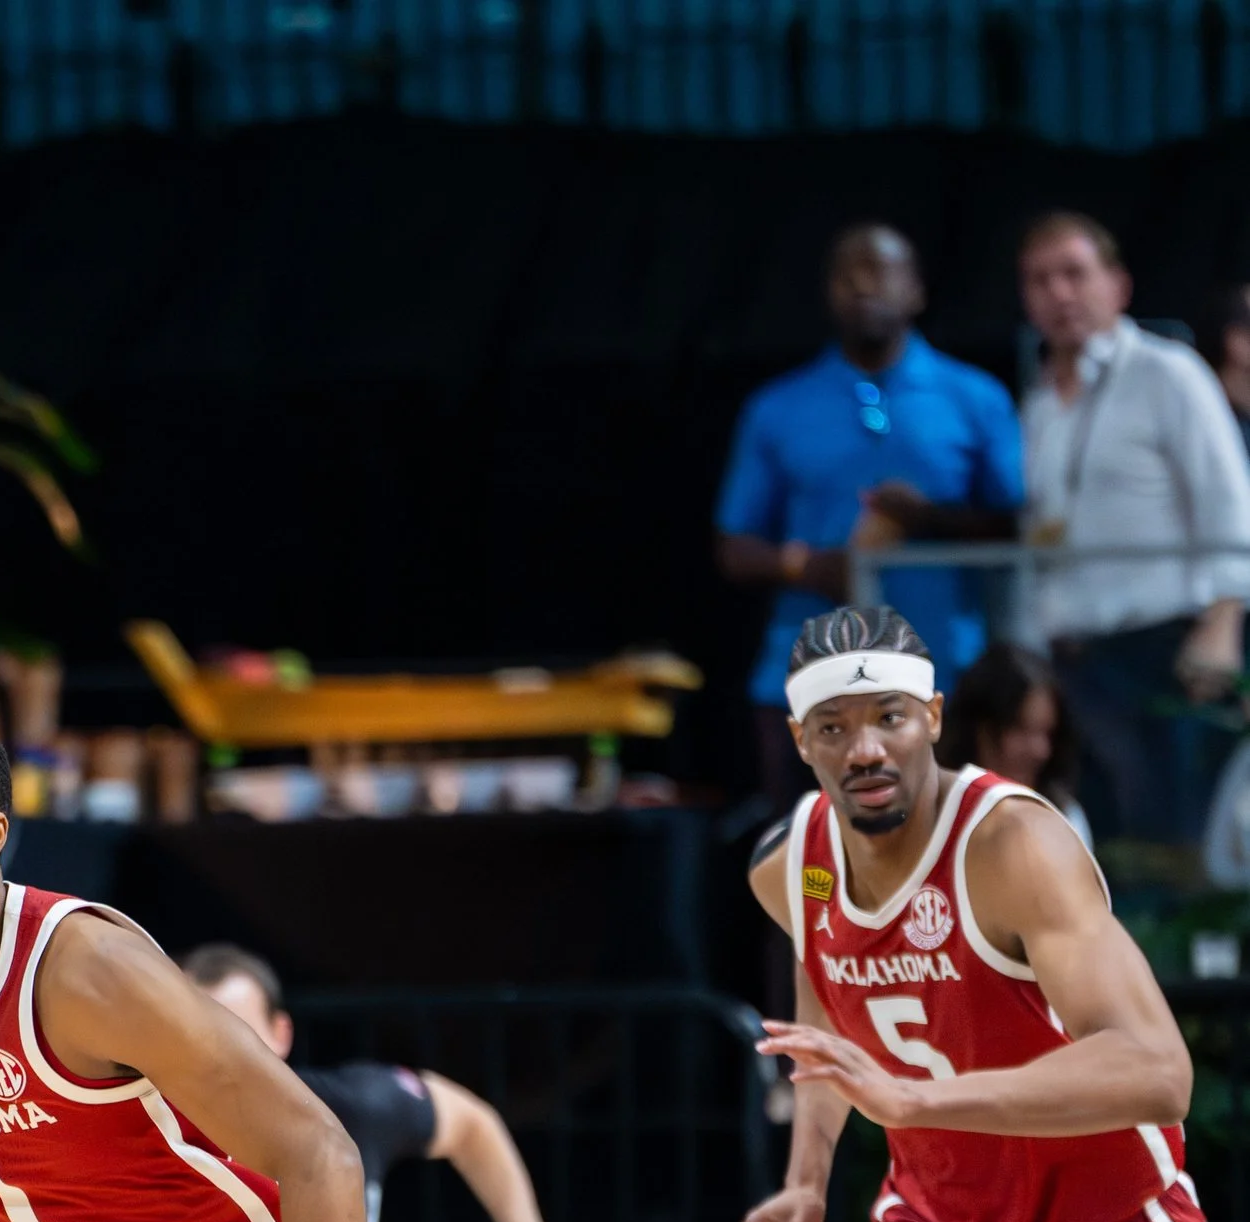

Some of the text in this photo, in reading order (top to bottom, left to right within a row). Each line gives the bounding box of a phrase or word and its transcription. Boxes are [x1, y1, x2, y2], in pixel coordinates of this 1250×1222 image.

[914, 891, 947, 933] SEC
[819, 953, 961, 987] OKLAHOMA
[865, 997, 956, 1080] 5
